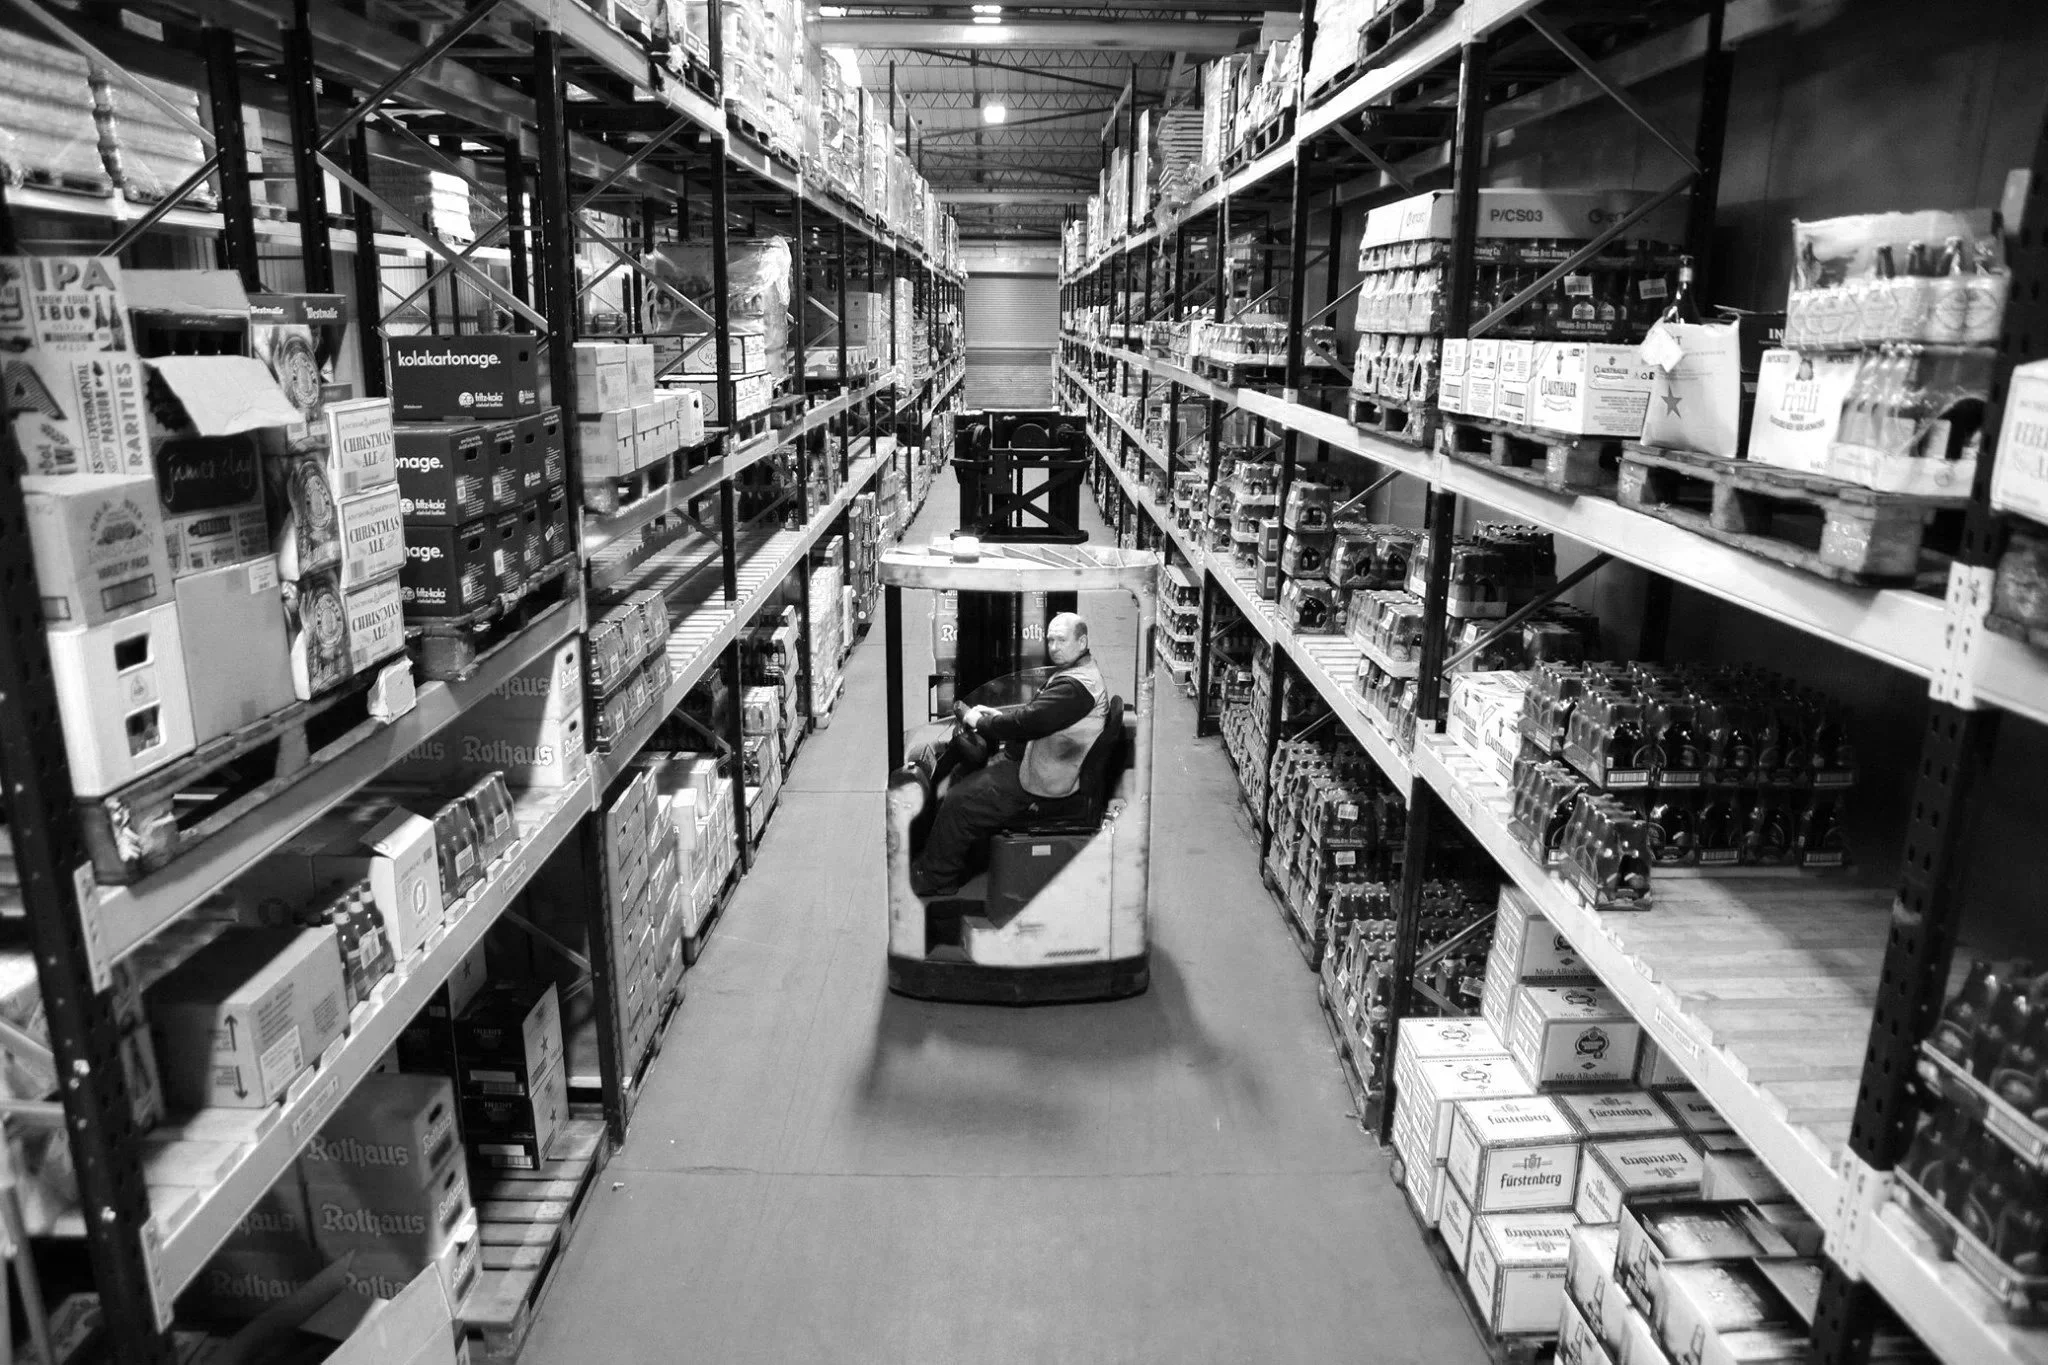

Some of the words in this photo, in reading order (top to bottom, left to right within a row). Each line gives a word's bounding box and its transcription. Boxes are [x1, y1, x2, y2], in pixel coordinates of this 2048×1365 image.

[1490, 208, 1543, 222] P/CS03
[29, 257, 115, 291] IPA
[397, 349, 502, 369] kolakartonage.
[78, 363, 99, 440] EXPERIMENTAL
[95, 391, 115, 443] PASSION
[116, 362, 143, 467] RARITIES
[344, 430, 392, 454] CHRISTMAS
[362, 450, 379, 469] ALE
[349, 515, 400, 545] CHRISTMAS
[368, 537, 386, 556] ALE
[352, 601, 400, 633] CHRISTMAS
[461, 735, 555, 769] Rothaus
[306, 1133, 410, 1168] Rothaus
[320, 1202, 426, 1237] Rothaus
